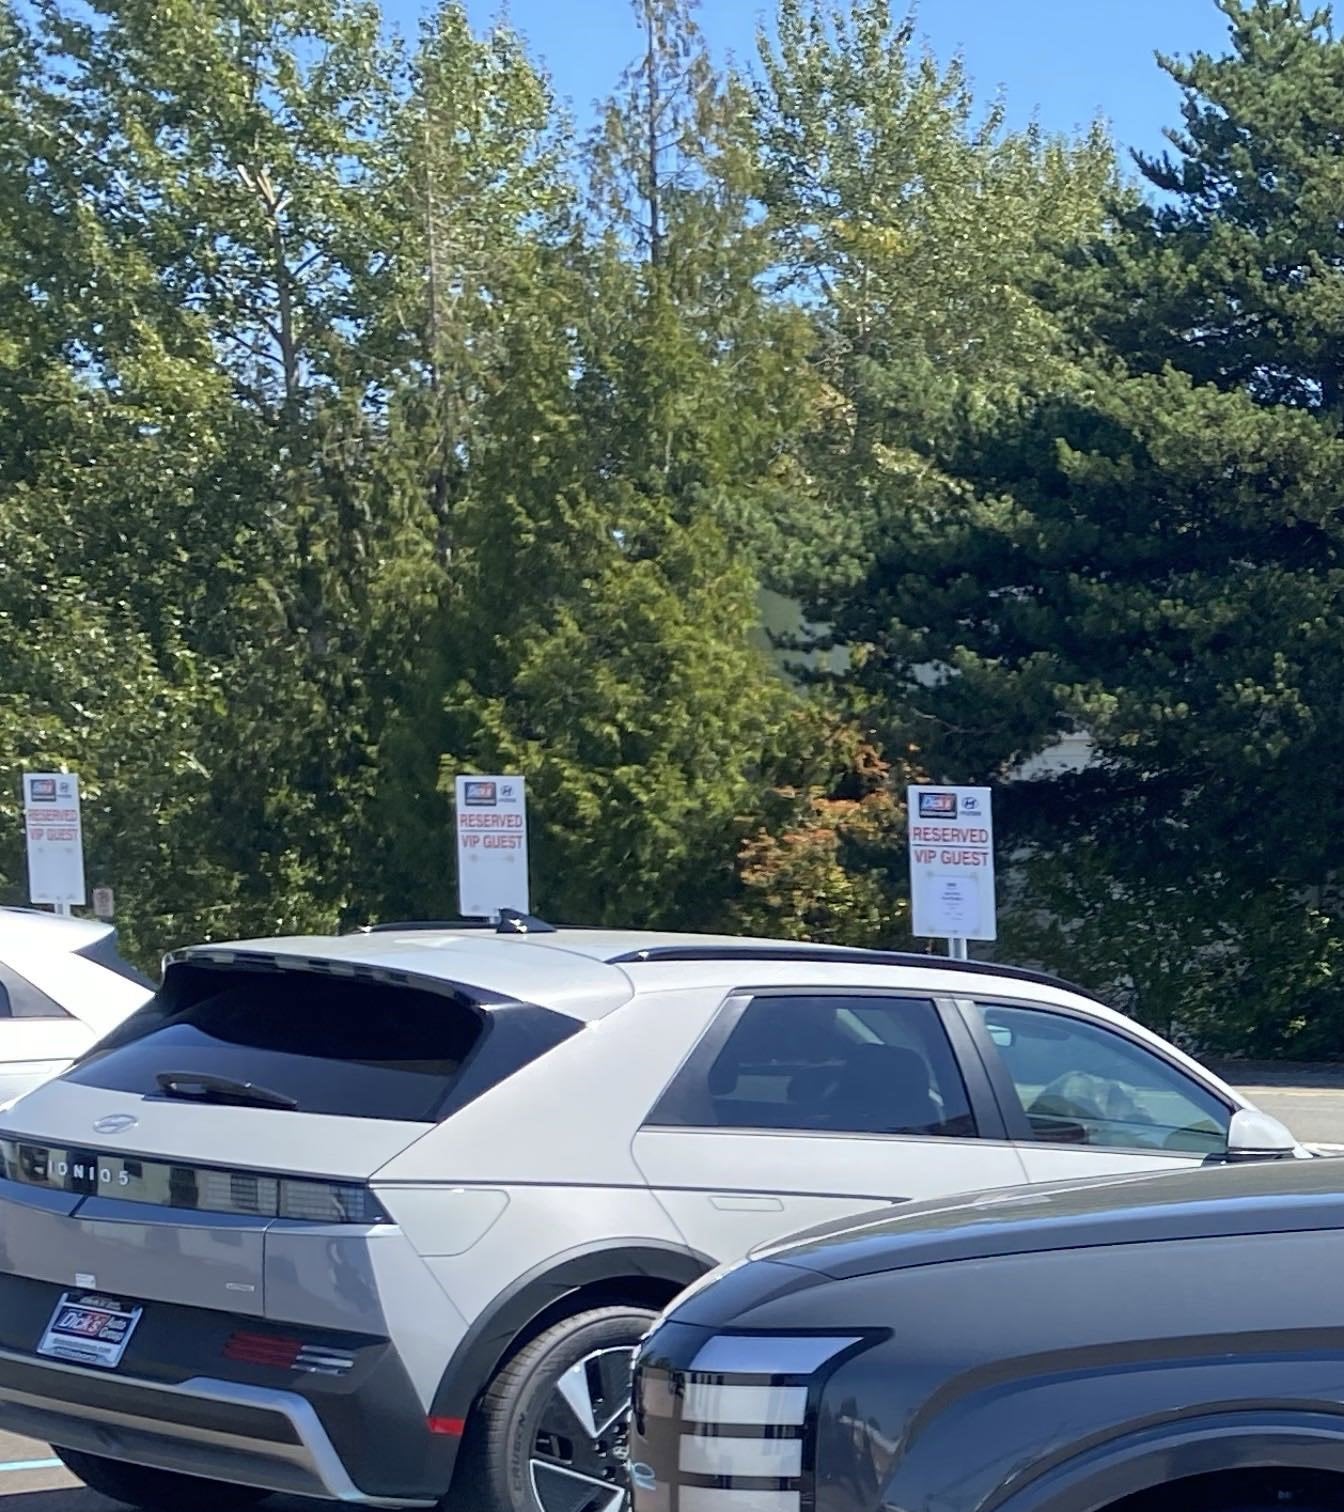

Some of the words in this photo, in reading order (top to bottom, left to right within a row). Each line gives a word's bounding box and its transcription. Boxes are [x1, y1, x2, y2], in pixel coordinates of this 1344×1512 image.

[460, 813, 523, 828] RESERVED
[461, 834, 481, 848] VIP
[483, 834, 523, 849] GUEST
[912, 826, 990, 844] RESERVED
[914, 849, 937, 865] VIP
[940, 850, 990, 867] GUEST
[119, 1170, 129, 1186] 5
